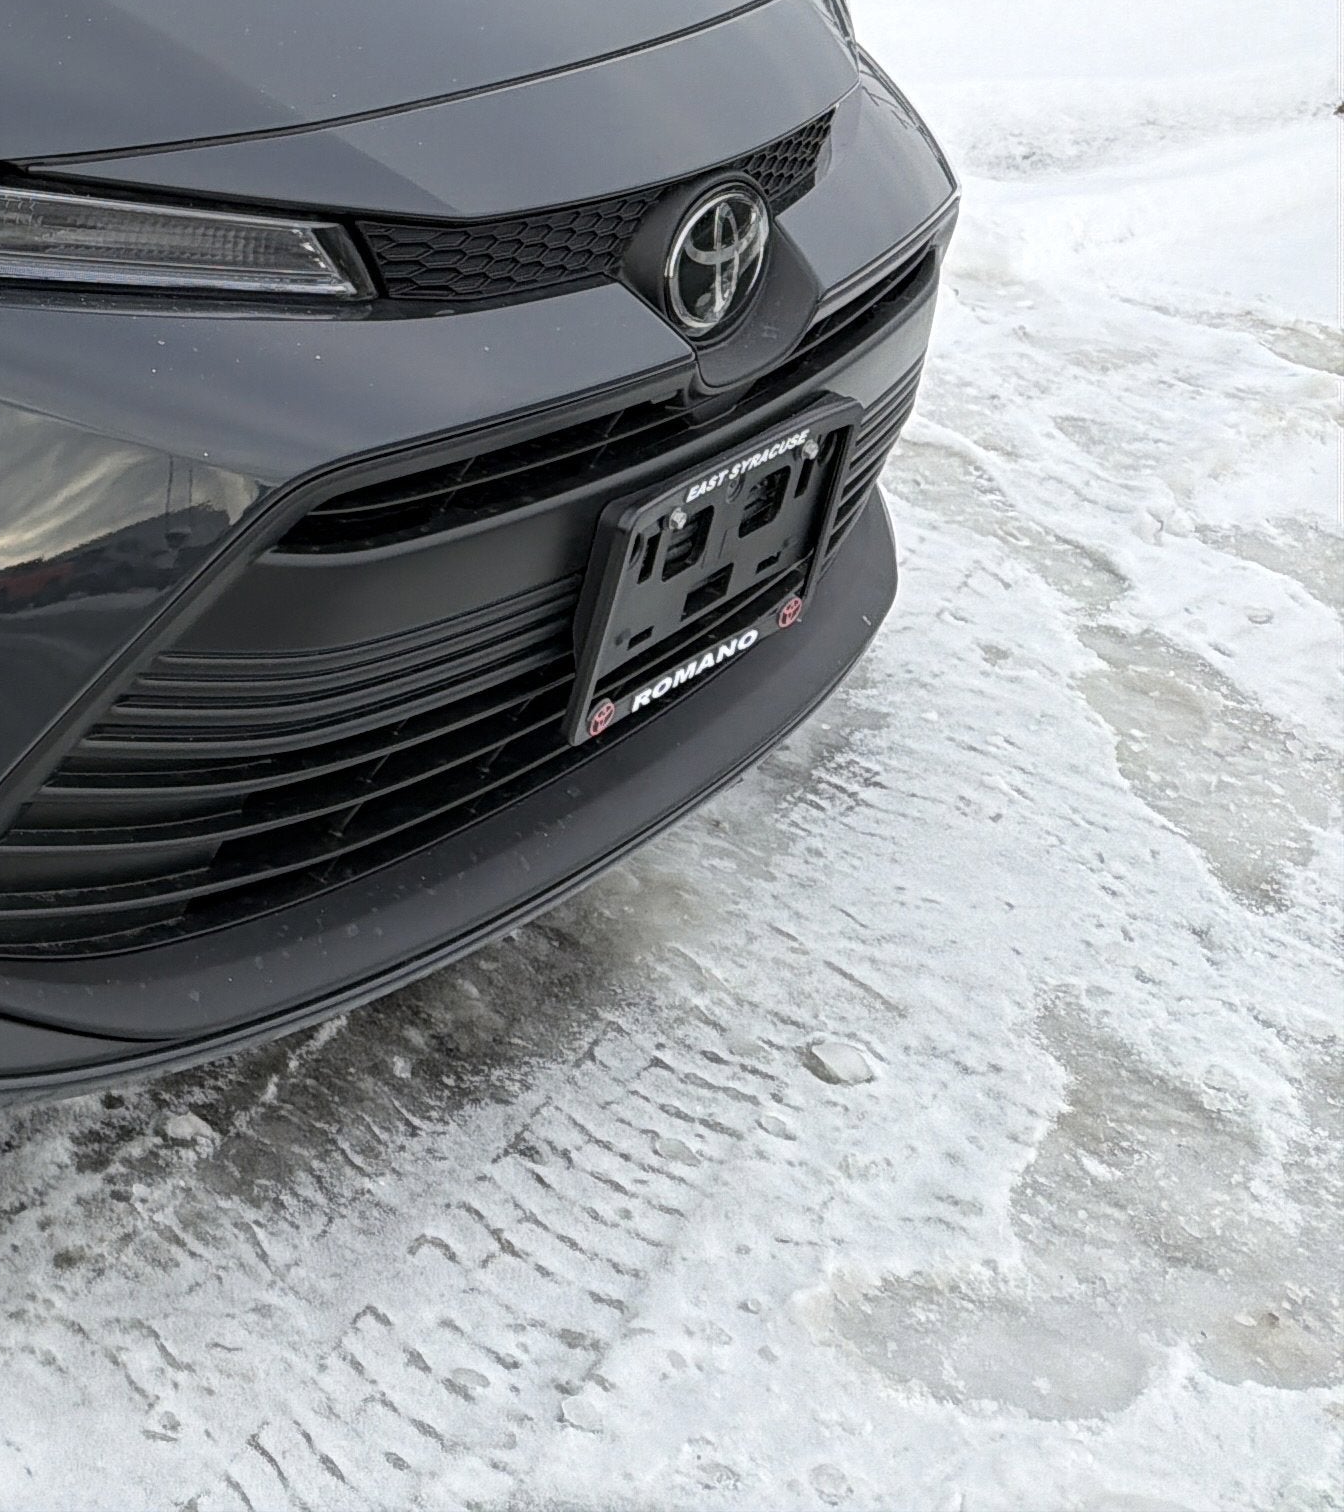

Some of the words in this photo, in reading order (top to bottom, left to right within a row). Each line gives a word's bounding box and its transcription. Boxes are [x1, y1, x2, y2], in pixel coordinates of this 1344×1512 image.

[685, 469, 729, 503] EAST
[728, 428, 810, 480] SYRACUSE
[631, 628, 759, 713] ROMANO
